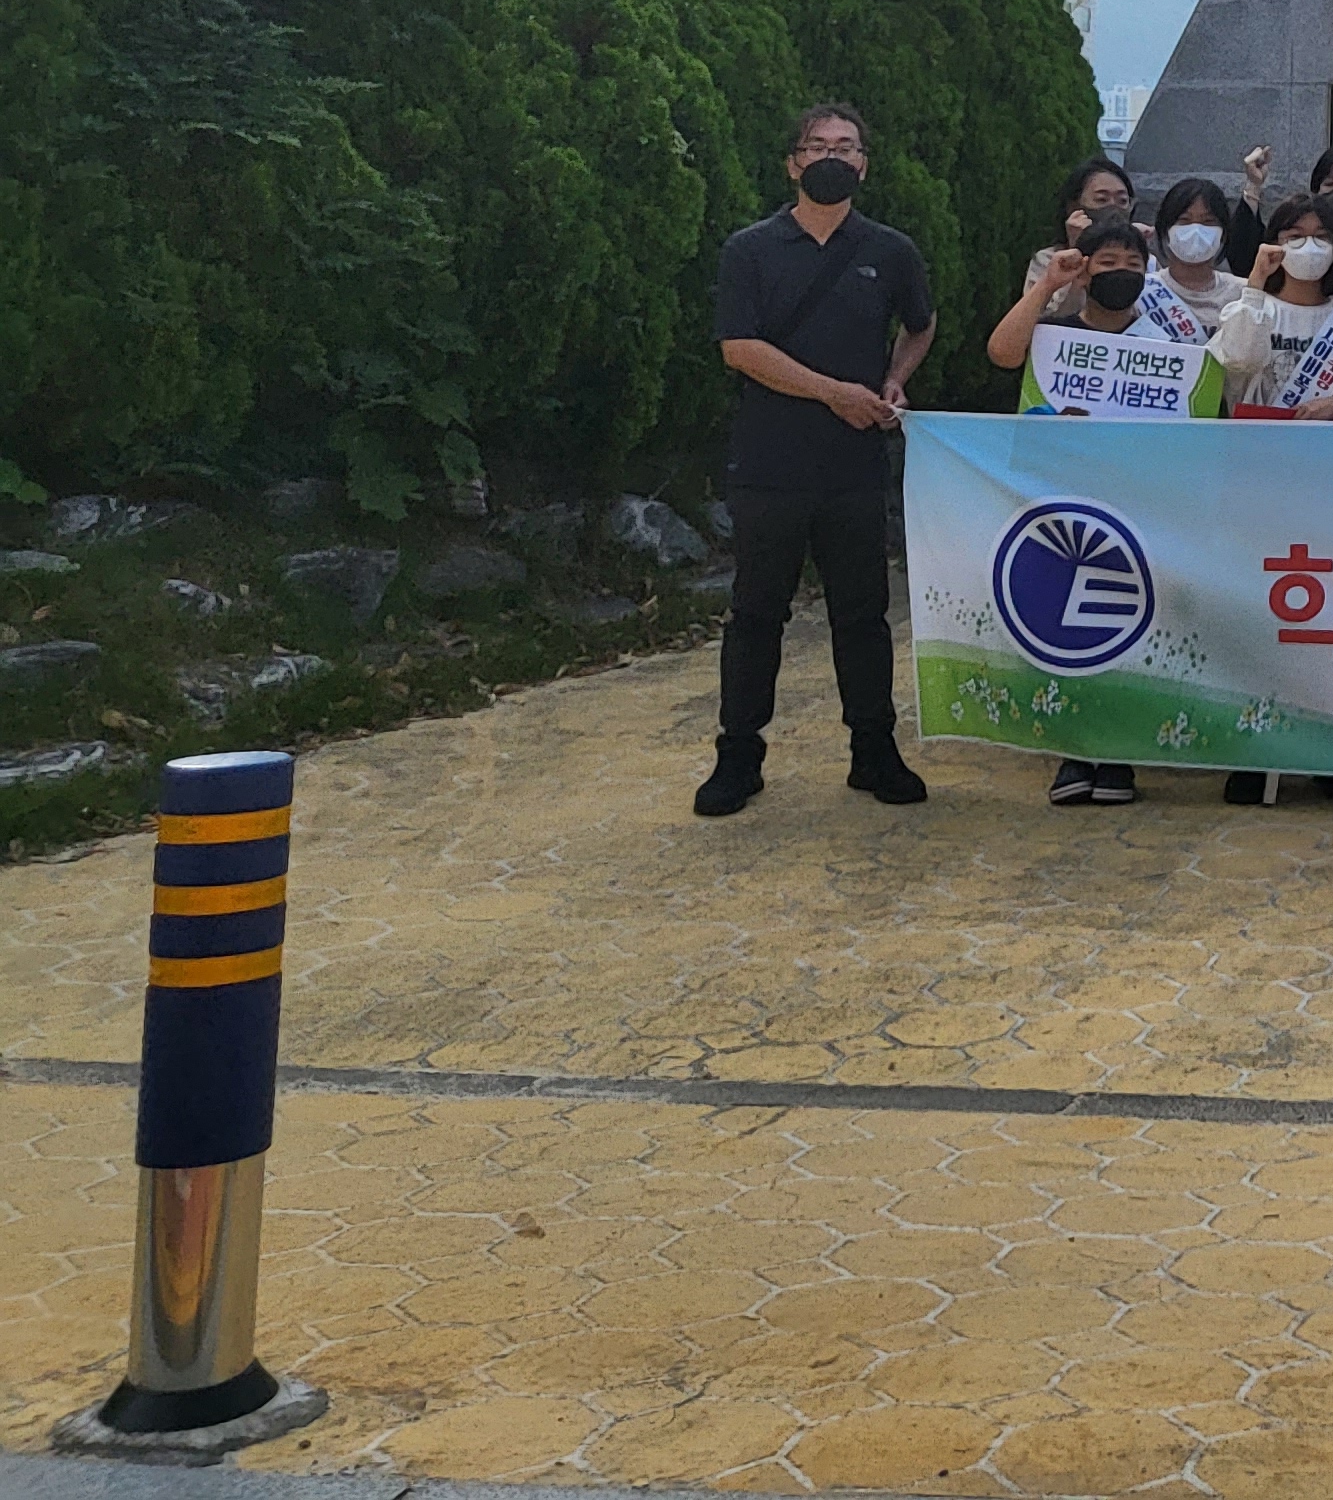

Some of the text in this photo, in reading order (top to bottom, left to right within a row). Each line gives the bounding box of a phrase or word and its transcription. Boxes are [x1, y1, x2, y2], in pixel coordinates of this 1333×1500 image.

[1054, 339, 1185, 381] 사람은 자연보호
[1049, 370, 1181, 412] 자연은 사람보호
